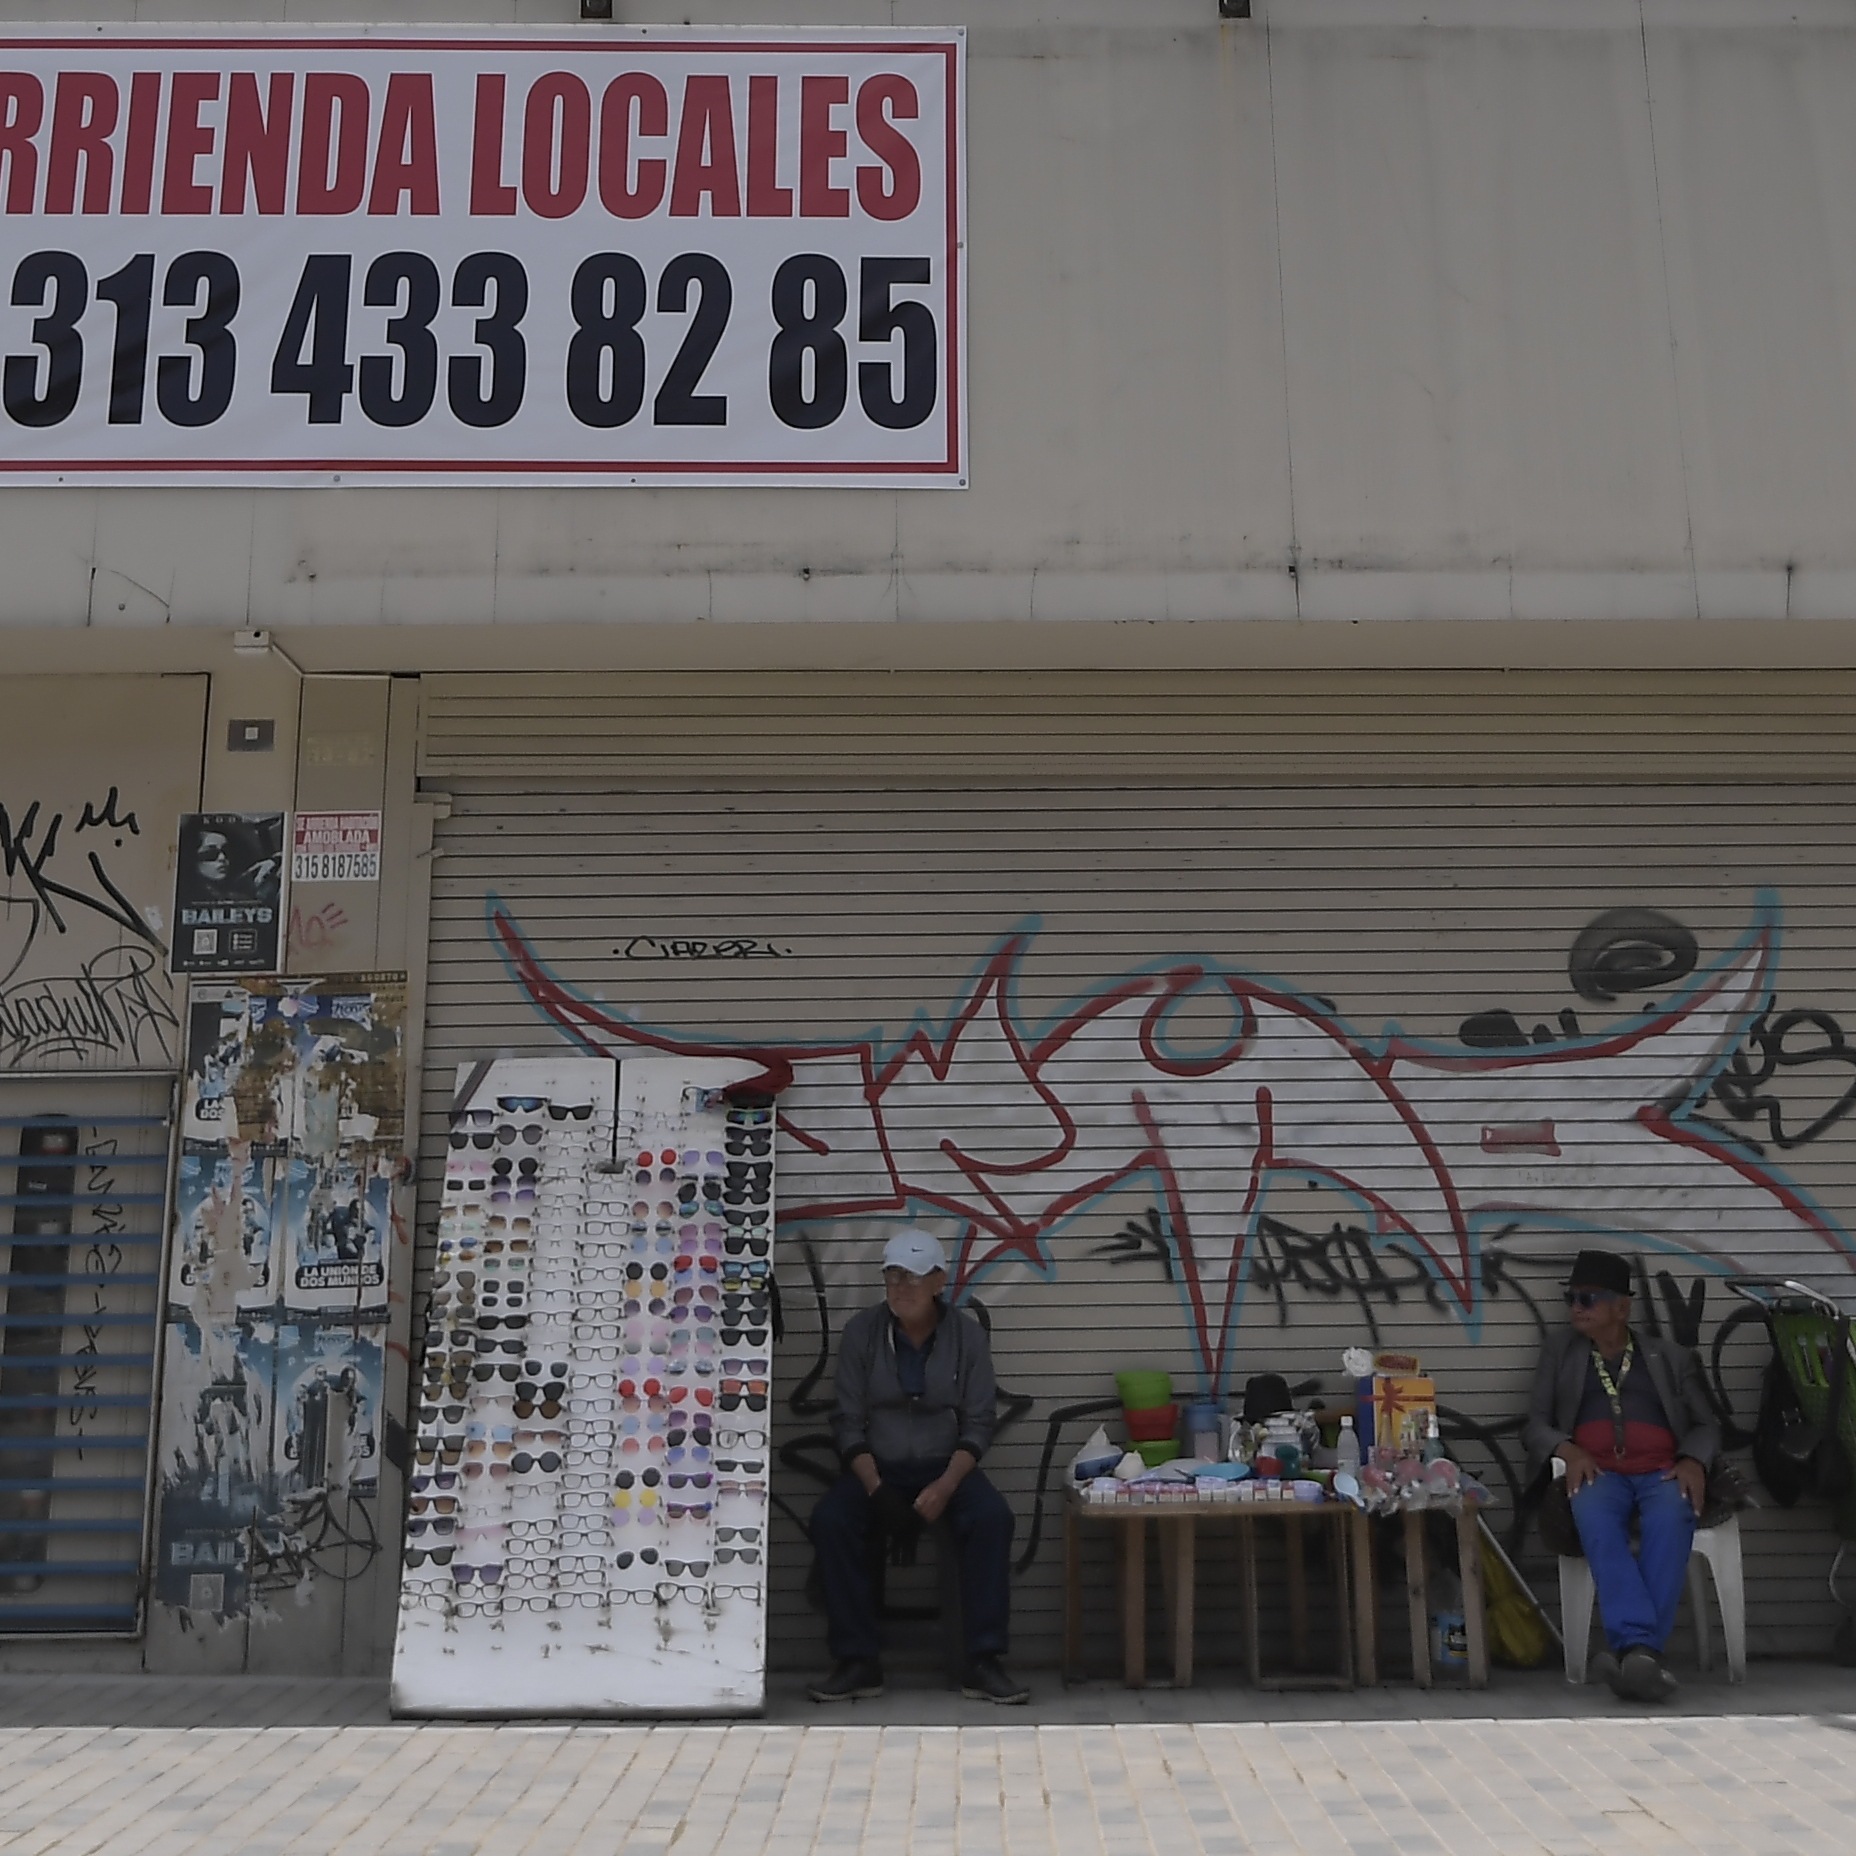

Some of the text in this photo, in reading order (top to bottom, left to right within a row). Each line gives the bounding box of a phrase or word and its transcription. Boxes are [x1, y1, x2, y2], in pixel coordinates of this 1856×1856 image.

[469, 71, 921, 221] LOCALES
[2, 251, 241, 428] 313
[271, 251, 529, 429] 433
[566, 252, 732, 430] 82
[769, 252, 936, 430] 85
[303, 830, 370, 844] AMOBLADA
[295, 853, 377, 879] 315 8187585
[181, 907, 273, 925] BAILEYS
[300, 1276, 325, 1287] DOS
[304, 1267, 319, 1277] LA
[361, 1265, 378, 1275] DE
[172, 1542, 248, 1566] BAIL
